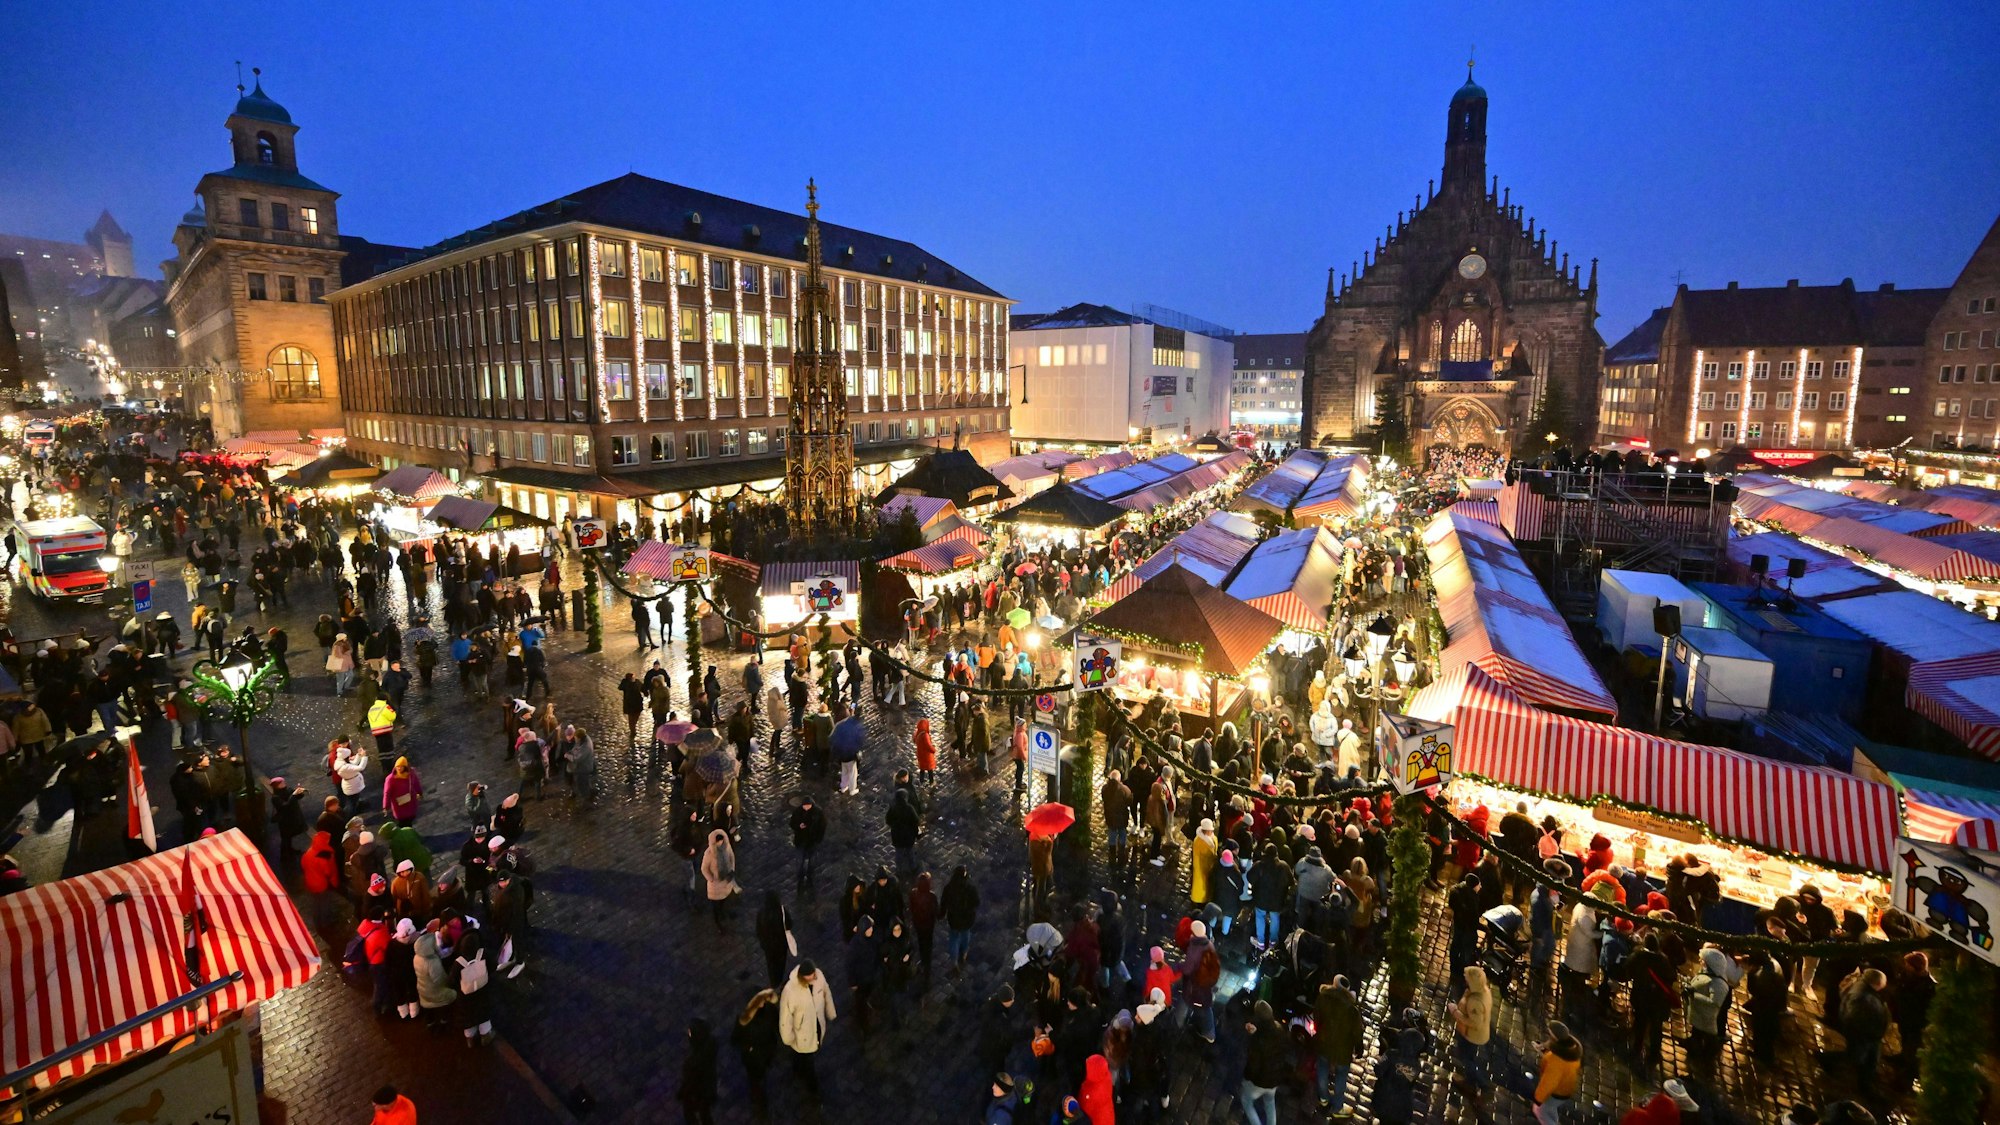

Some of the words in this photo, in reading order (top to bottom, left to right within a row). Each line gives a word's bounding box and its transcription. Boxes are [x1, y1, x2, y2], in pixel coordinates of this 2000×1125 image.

[1753, 452, 1781, 460] BLOCK
[1783, 452, 1814, 460] HOUSE
[136, 600, 151, 610] TAXI
